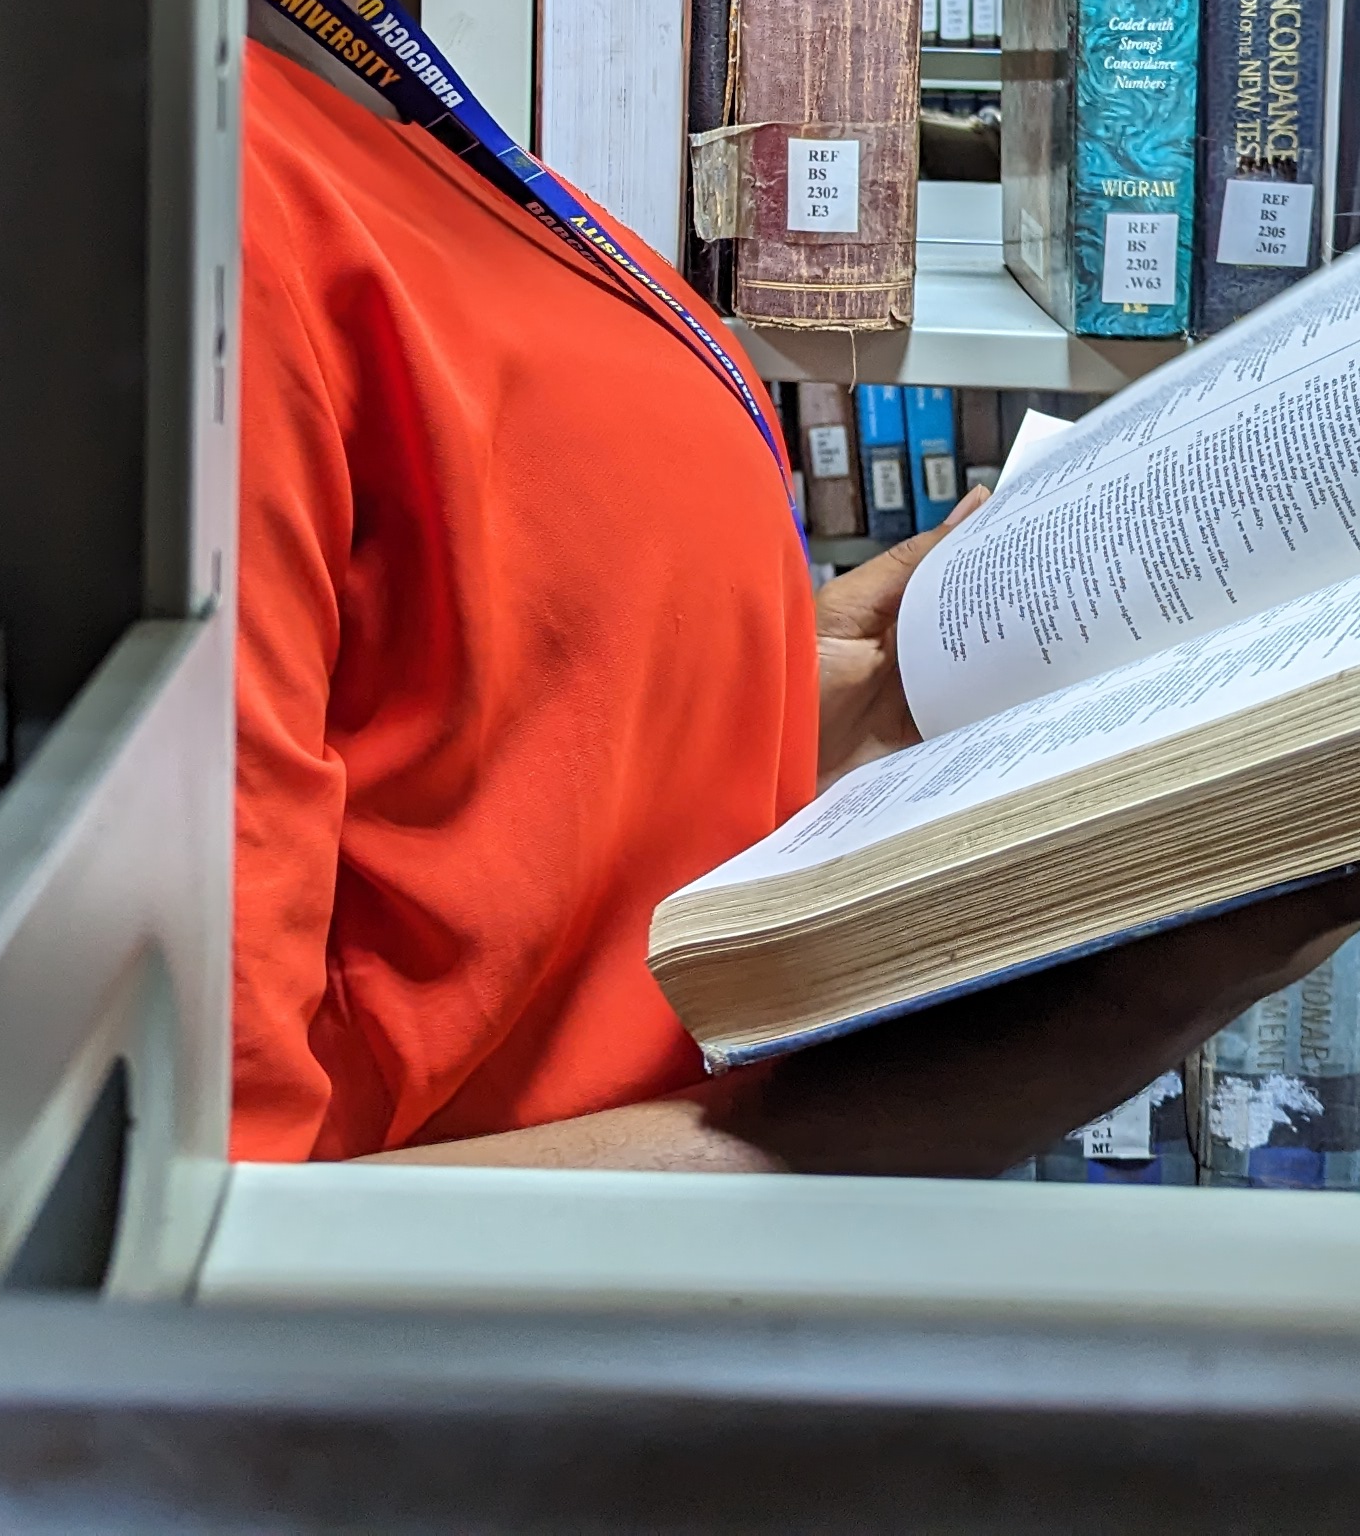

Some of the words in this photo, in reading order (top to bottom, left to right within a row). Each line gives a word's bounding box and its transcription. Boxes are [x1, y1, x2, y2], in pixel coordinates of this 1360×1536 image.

[1108, 16, 1144, 32] Coded
[1146, 17, 1174, 32] with
[1240, 19, 1252, 33] OF
[372, 12, 464, 109] BABCOCK
[1104, 56, 1177, 70] Concordance
[1114, 76, 1166, 90] Numbers
[1238, 60, 1262, 112] NEW
[1236, 118, 1261, 166] TES
[808, 150, 840, 162] REF
[808, 168, 827, 180] BS
[806, 186, 839, 199] 2302
[1102, 180, 1176, 197] WIGRAM
[1262, 193, 1289, 206] REF
[806, 205, 830, 218] .E3
[1260, 210, 1277, 221] BS
[1128, 222, 1160, 234] REF
[1258, 226, 1286, 238] 2305
[1128, 240, 1146, 252] BS
[1256, 242, 1286, 254] .M67
[570, 216, 684, 312] UNIVERSITY
[1126, 258, 1158, 270] 2302
[1126, 276, 1162, 289] .W63
[684, 316, 760, 416] BABCOCK
